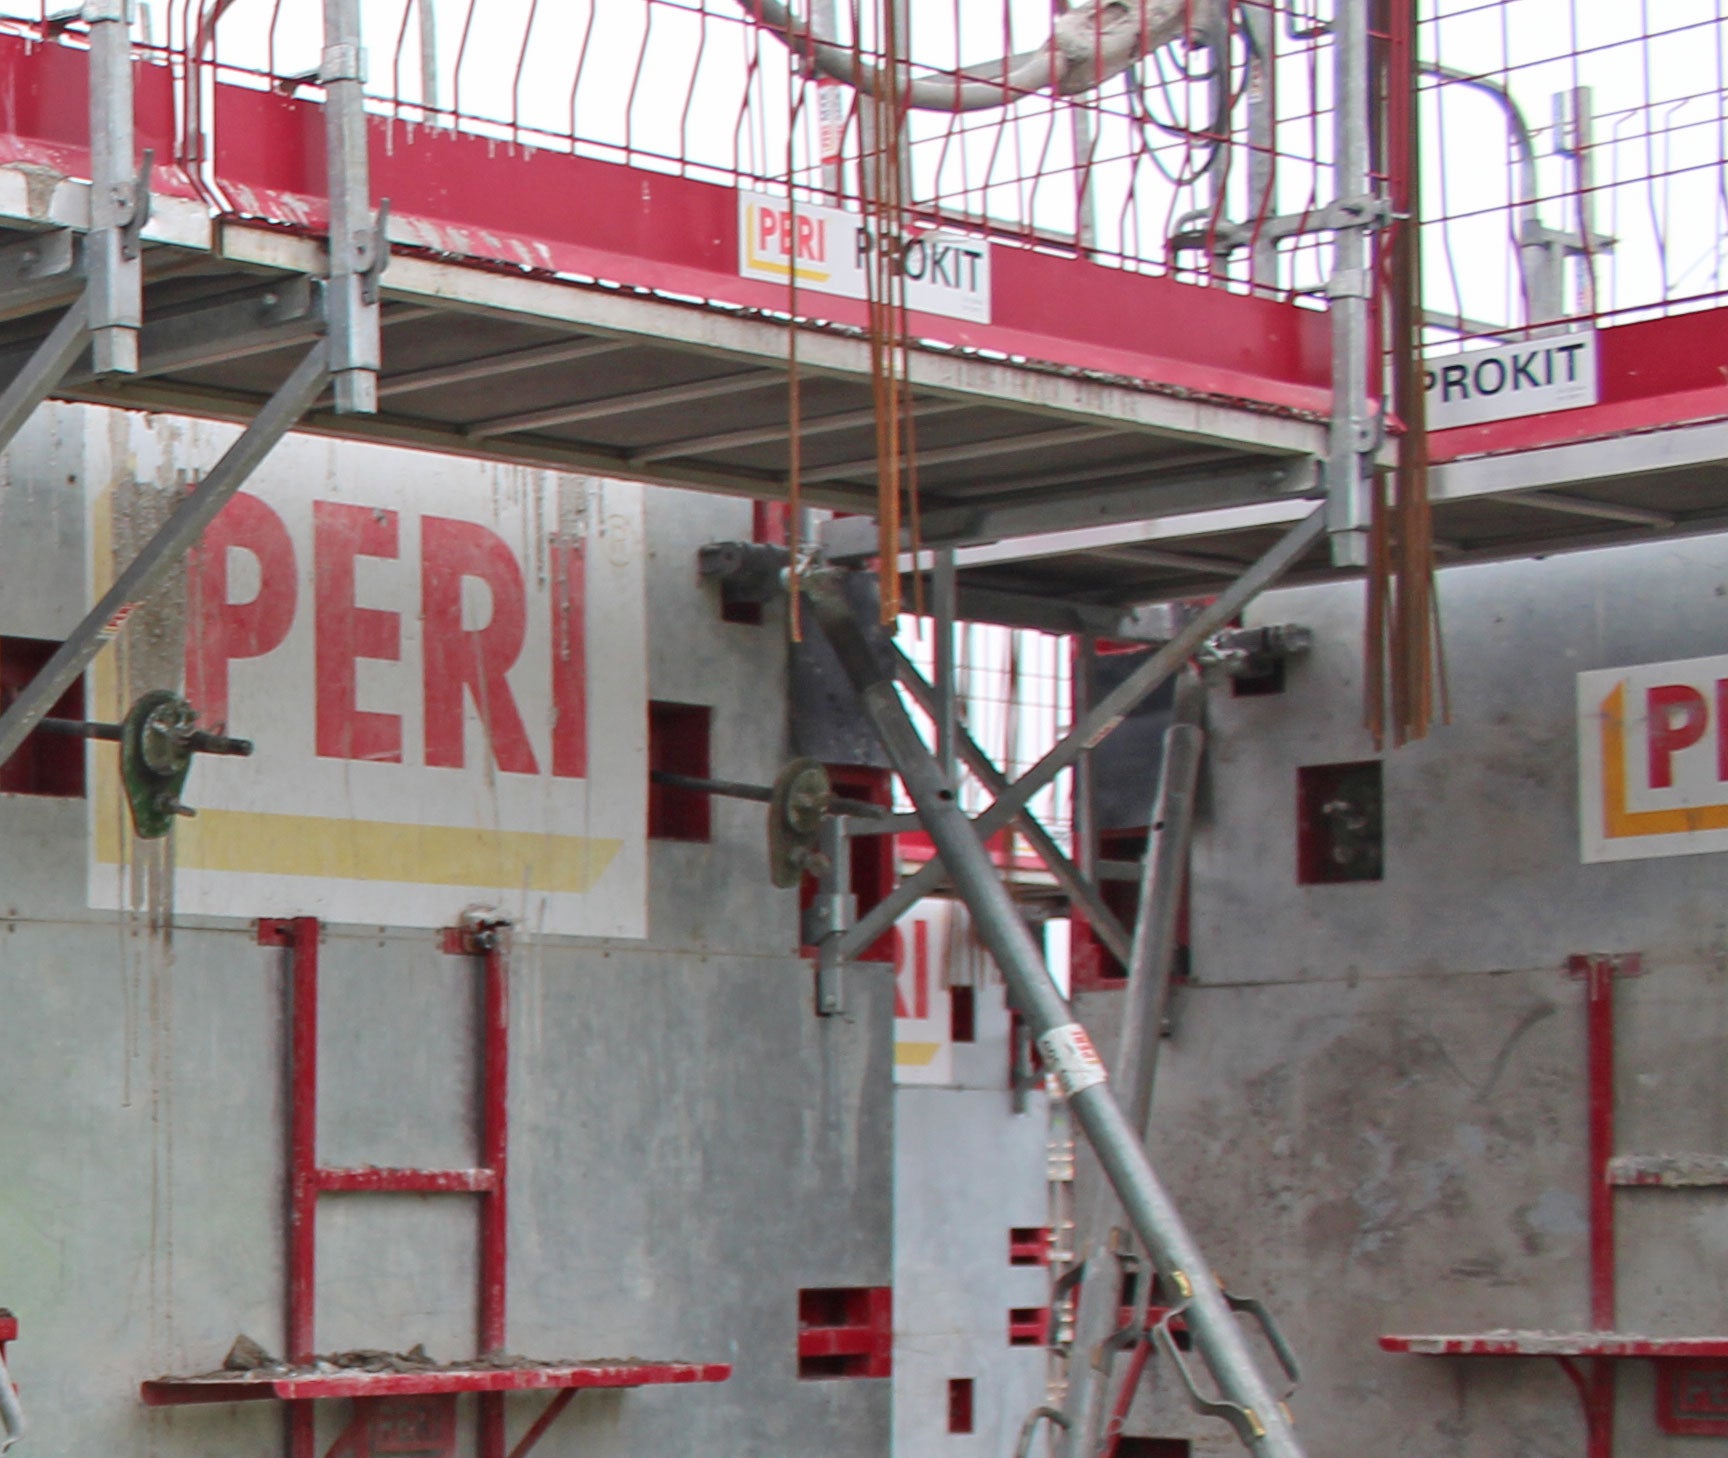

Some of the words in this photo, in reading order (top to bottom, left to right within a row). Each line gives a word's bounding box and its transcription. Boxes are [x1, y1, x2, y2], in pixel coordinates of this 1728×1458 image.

[759, 207, 827, 262] PERI
[185, 483, 587, 778] PERI
[1647, 678, 1728, 789] P
